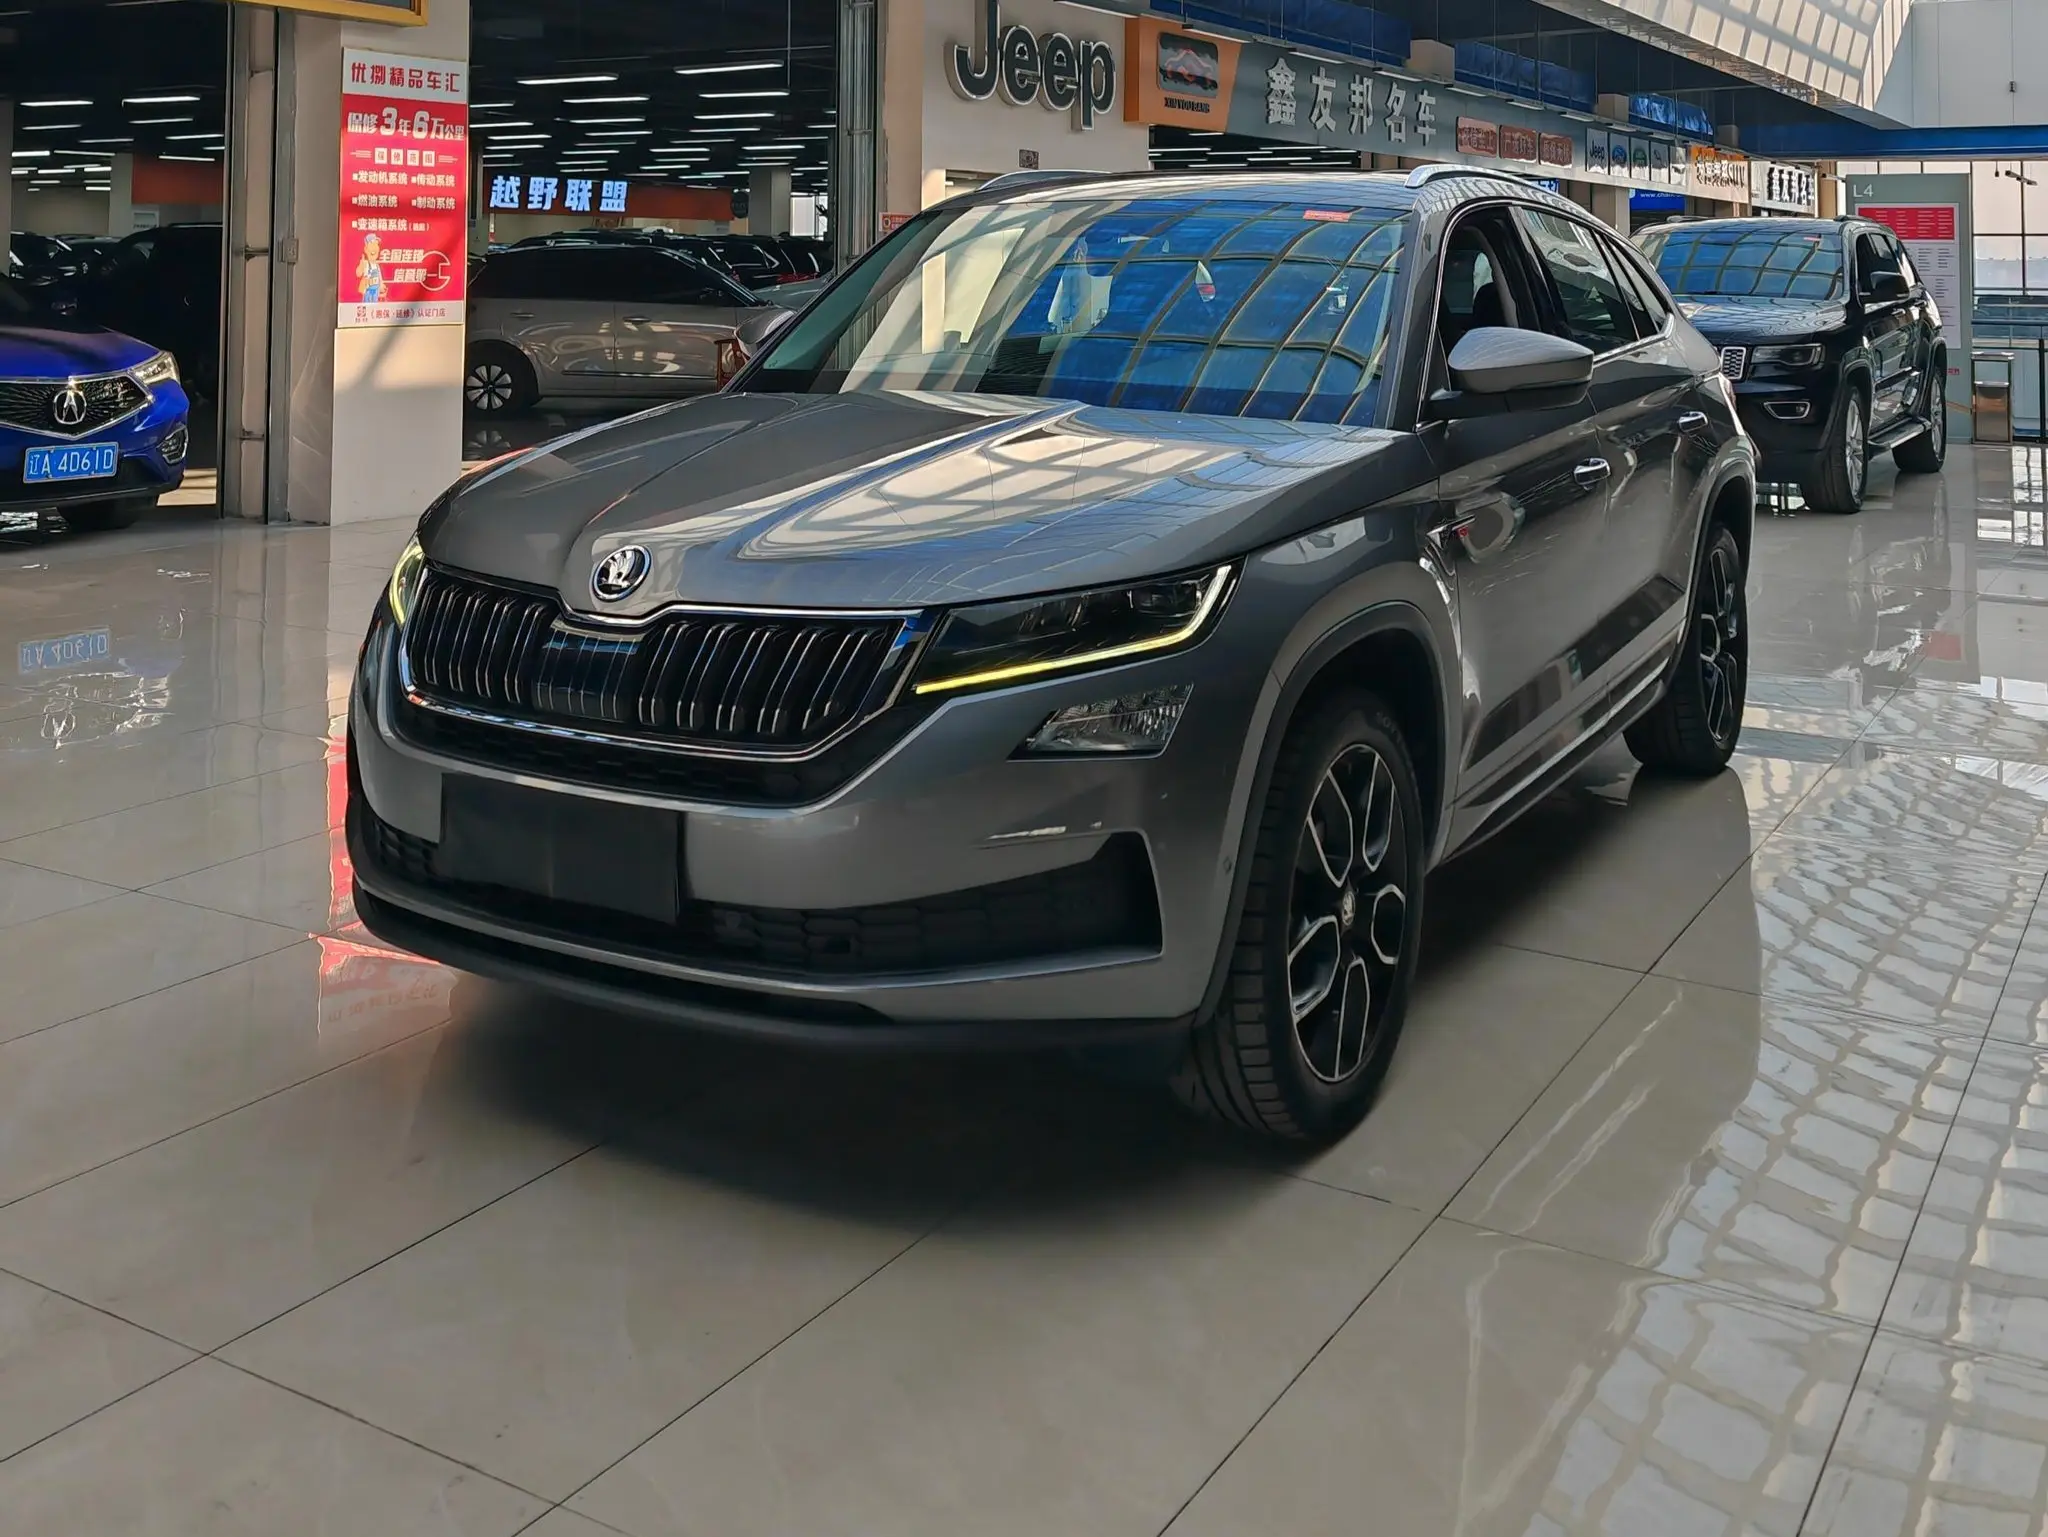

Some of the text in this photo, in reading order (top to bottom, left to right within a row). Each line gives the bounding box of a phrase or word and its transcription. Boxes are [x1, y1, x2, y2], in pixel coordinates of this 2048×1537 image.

[351, 62, 461, 93] 优捌精品车汇
[944, 0, 1117, 131] Jeep
[1266, 57, 1438, 146] 鑫友邦名车
[347, 106, 465, 141] 保修3年6万公里
[358, 170, 408, 185] 发动机系统
[489, 175, 629, 213] 越野联盟
[1852, 184, 1875, 198] L4
